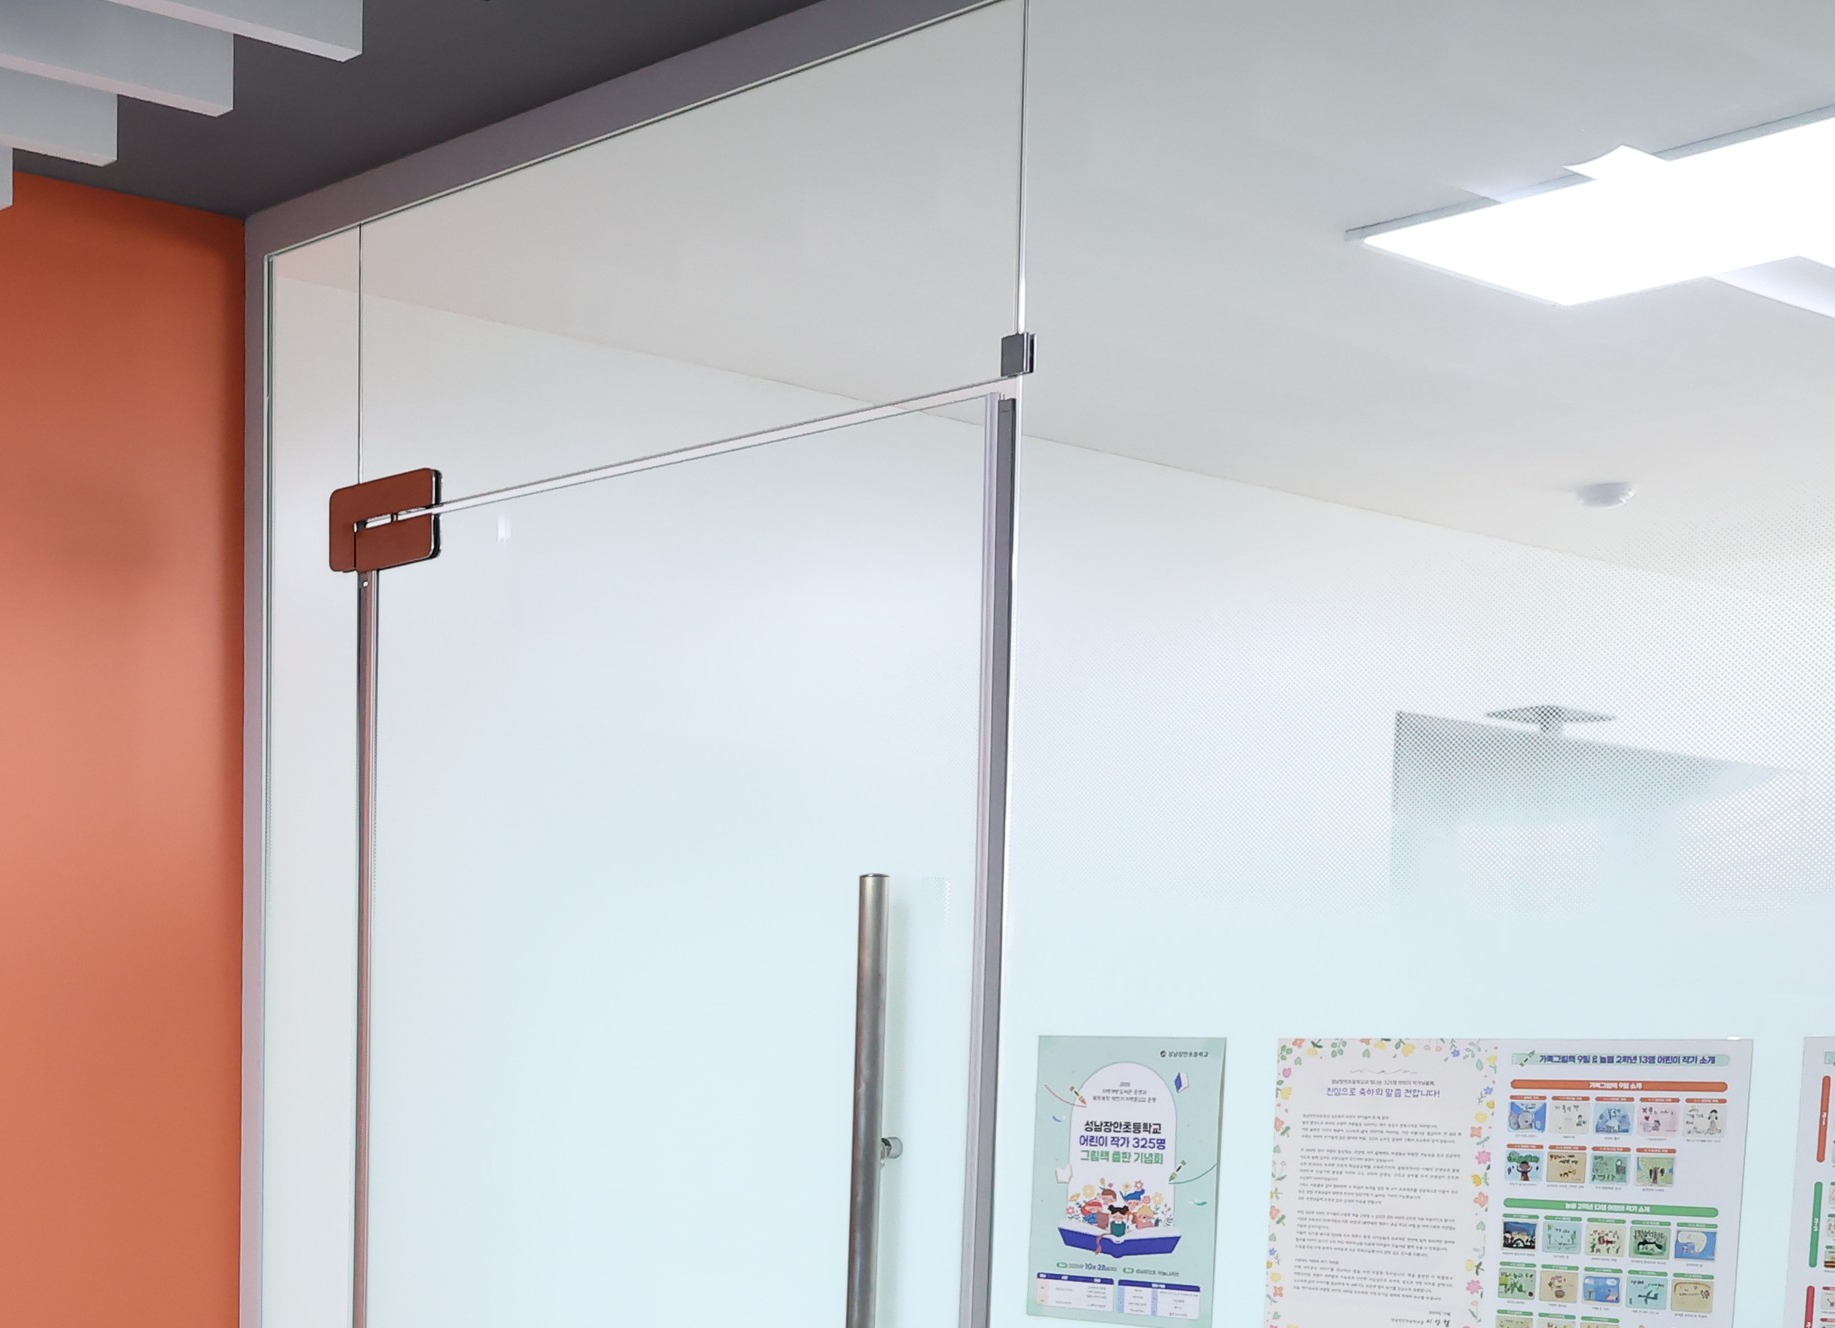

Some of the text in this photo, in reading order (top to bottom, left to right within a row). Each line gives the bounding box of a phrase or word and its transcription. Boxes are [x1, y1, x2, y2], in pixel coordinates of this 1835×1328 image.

[1326, 1087, 1356, 1097] 진심으로
[1358, 1088, 1383, 1098] 축하의
[1084, 1120, 1162, 1135] 성남장안초등학교
[1079, 1135, 1166, 1150] 어린이 작가 325명
[1080, 1150, 1164, 1165] 그림책 출판 기념회
